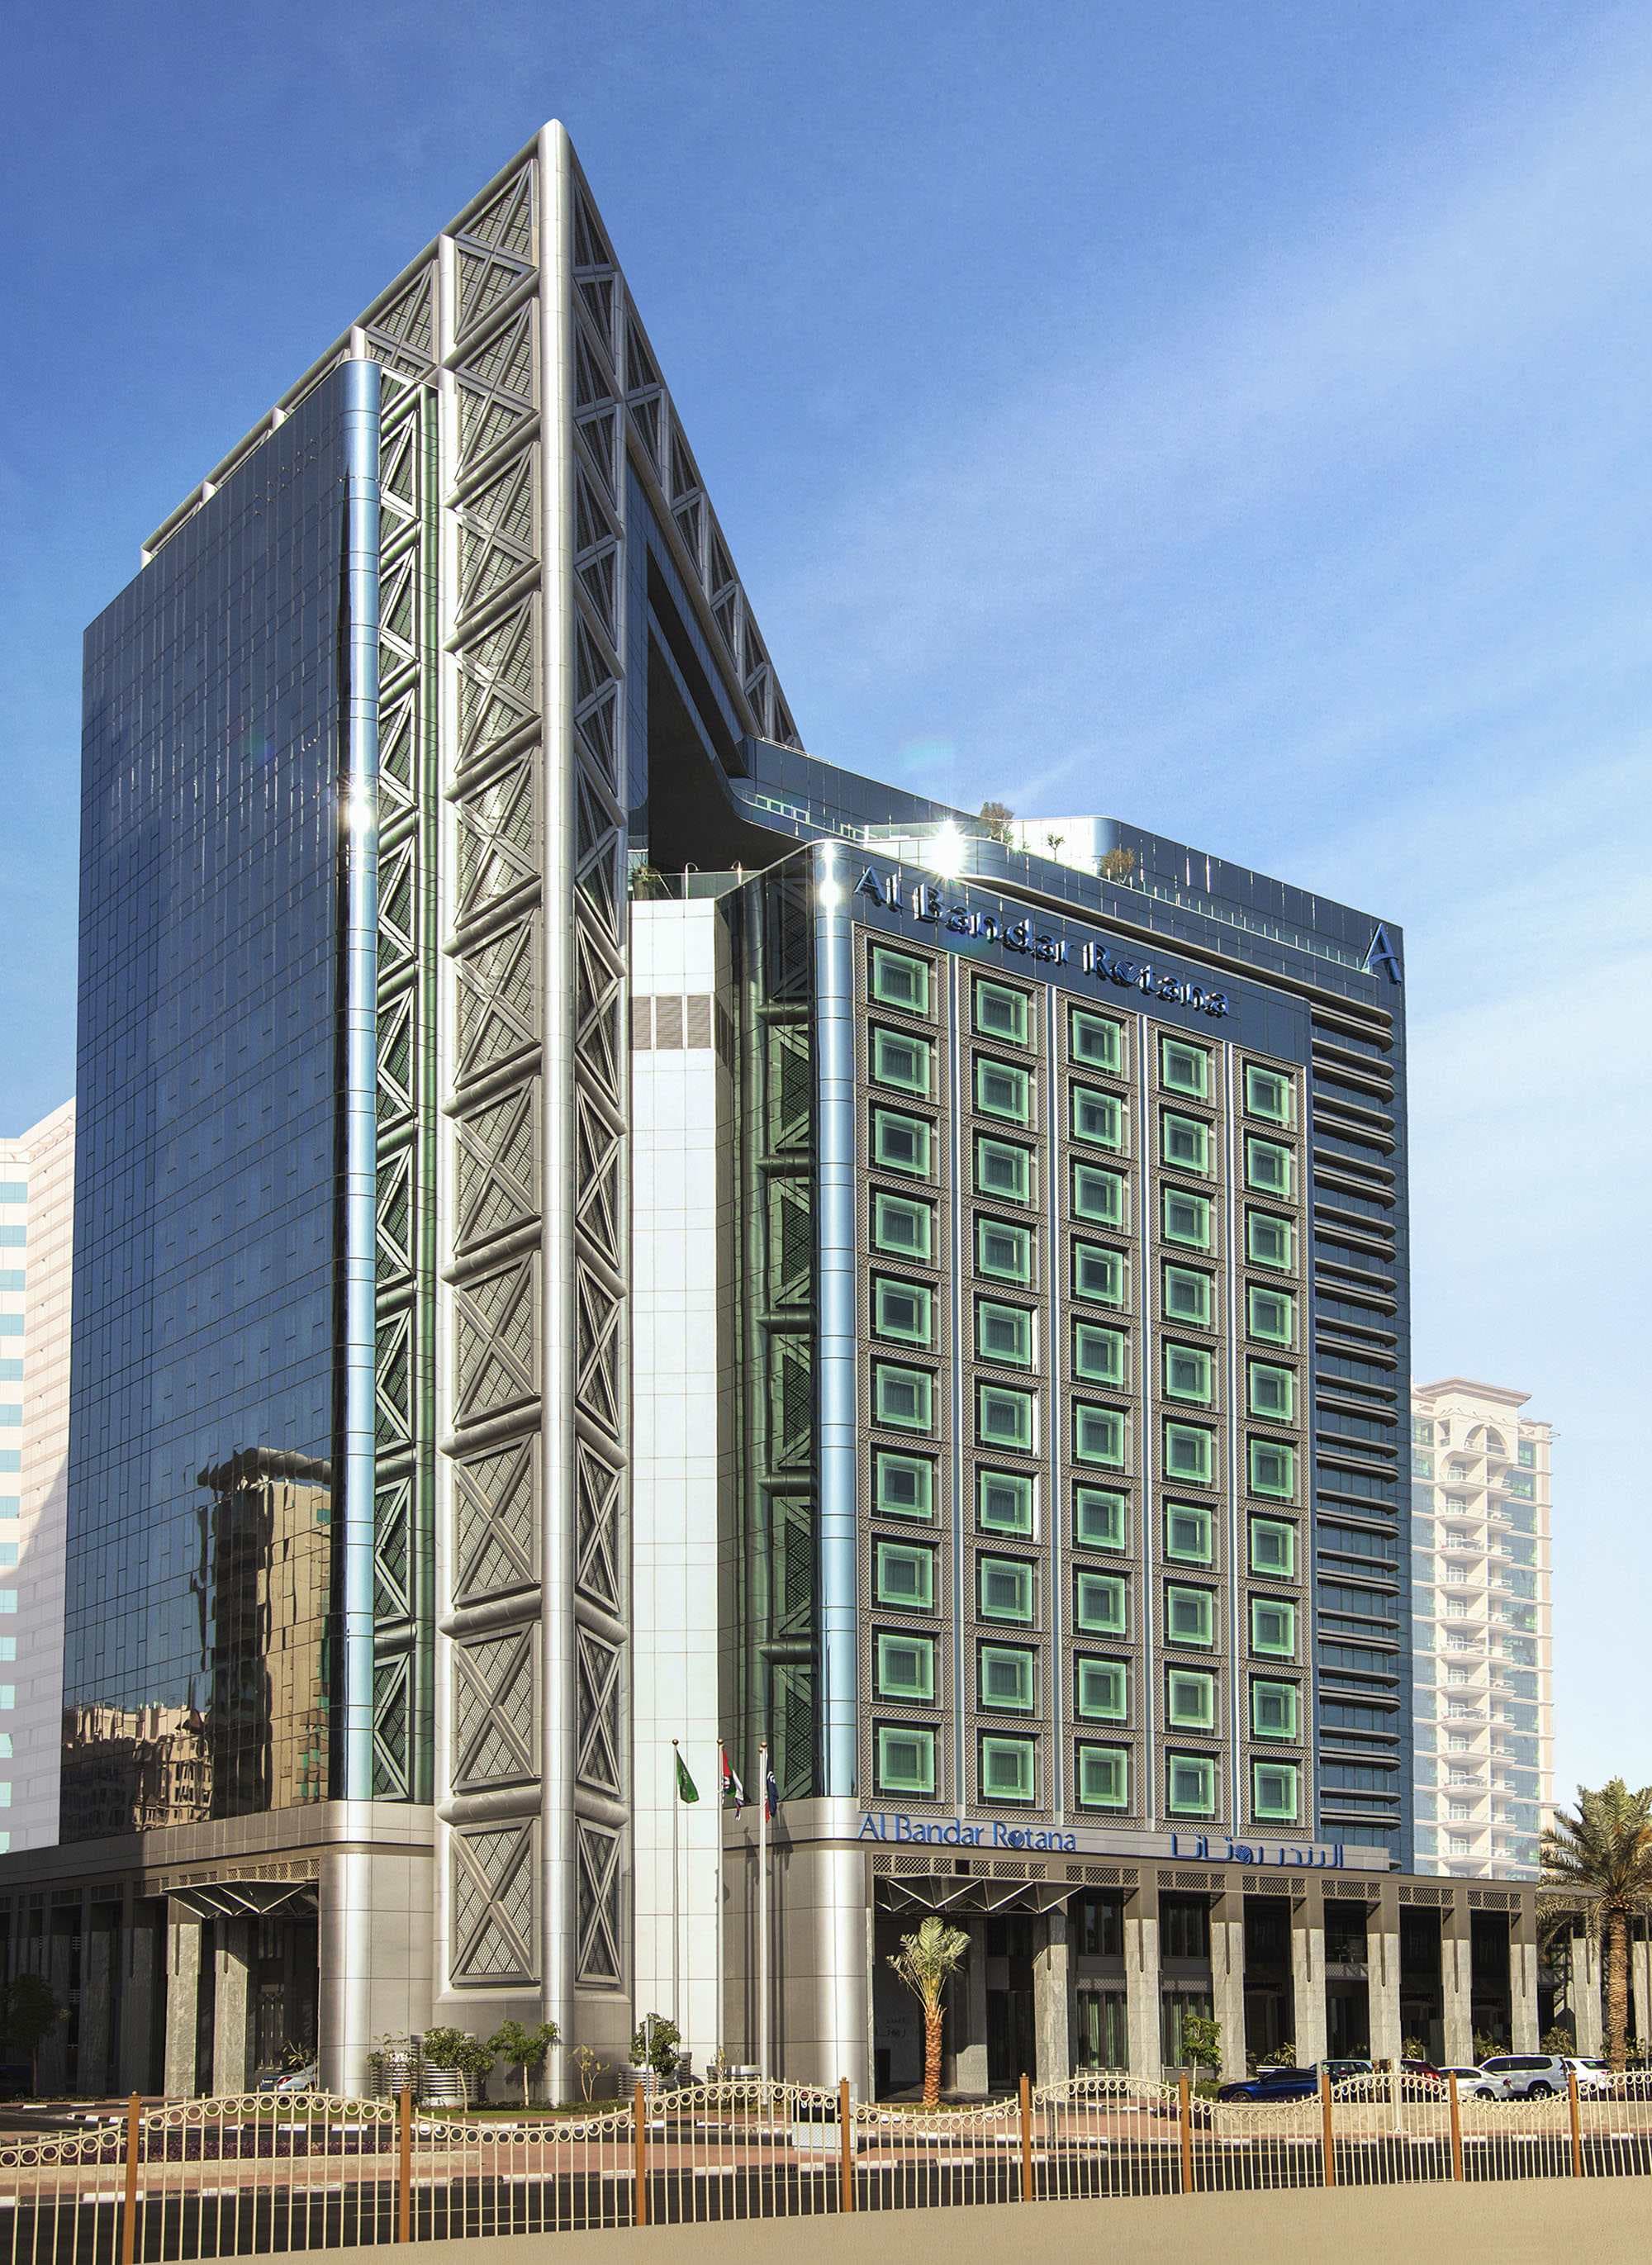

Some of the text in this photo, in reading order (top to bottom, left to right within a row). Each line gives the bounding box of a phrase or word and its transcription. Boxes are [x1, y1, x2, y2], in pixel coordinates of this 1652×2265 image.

[853, 865, 1230, 1019] Al Bandar Rotana
[858, 1812, 1077, 1852] Al Bandar Rotana
[1170, 1832, 1344, 1869] البندر روتانا
